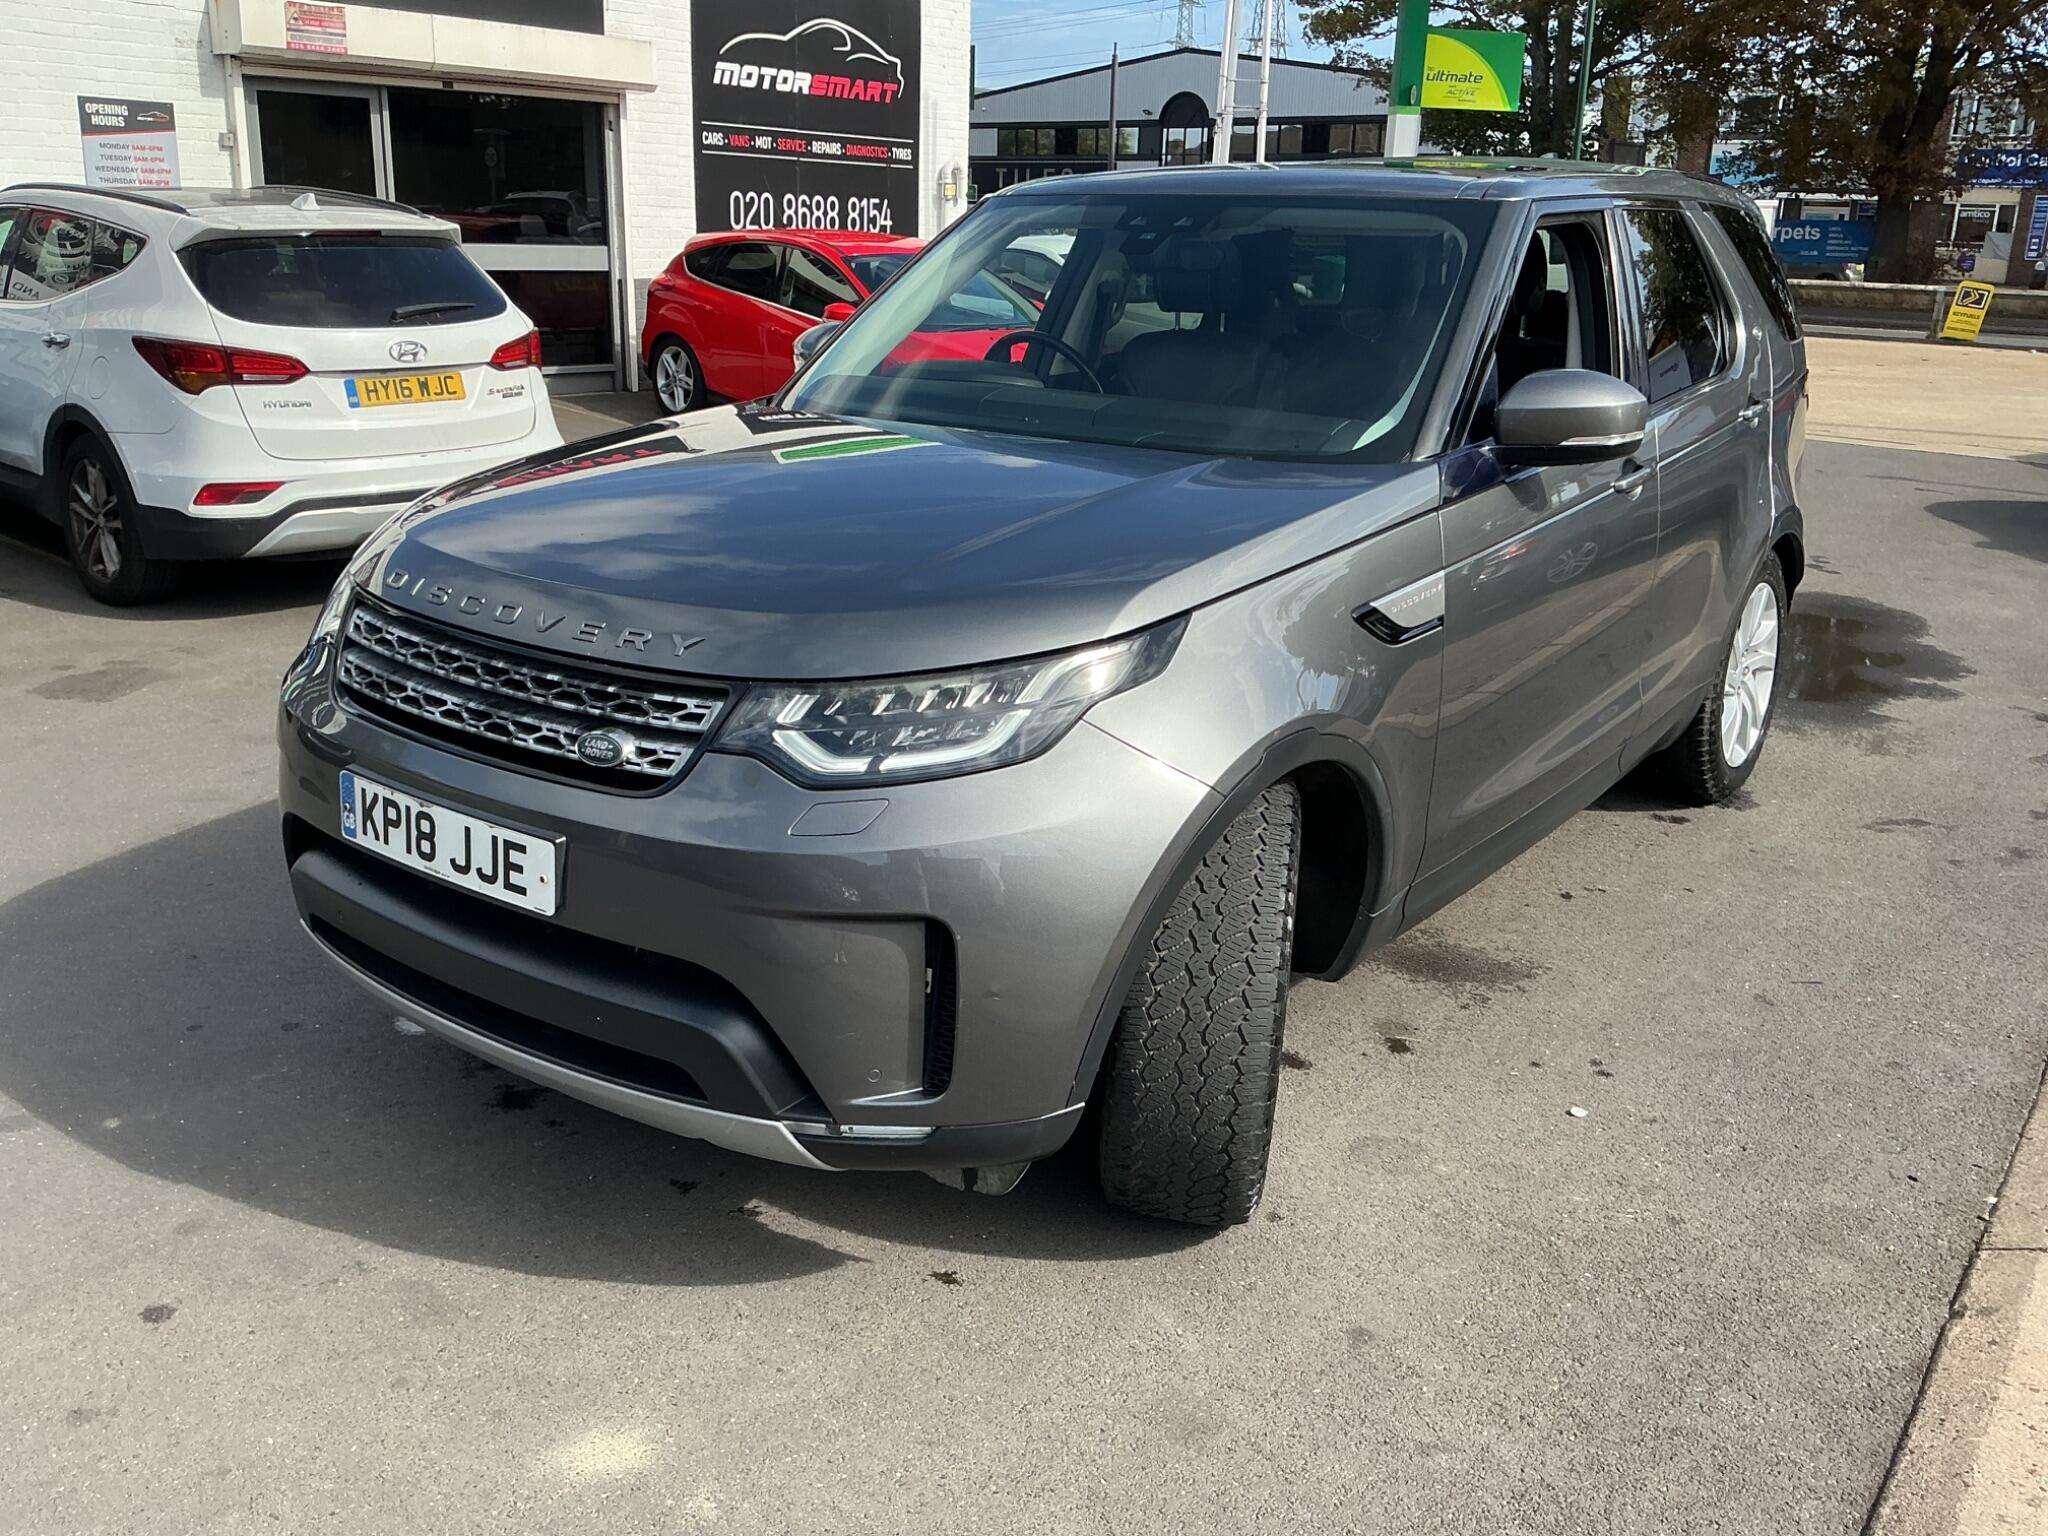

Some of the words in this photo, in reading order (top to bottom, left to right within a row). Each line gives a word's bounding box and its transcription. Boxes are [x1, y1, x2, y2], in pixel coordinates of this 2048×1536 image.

[713, 61, 898, 103] MOTORSMART
[1426, 70, 1483, 84] ultimate
[84, 102, 129, 116] OPENING
[91, 114, 126, 127] HOURS
[100, 142, 130, 151] MONDAY
[702, 131, 725, 146] CARS
[728, 134, 751, 148] VANS
[755, 137, 773, 150] MOT
[777, 138, 808, 152] SERVICE
[811, 140, 842, 156] REPAIRS
[846, 143, 888, 159] DIAGNOSTICS
[892, 147, 913, 161] TYRES
[100, 154, 132, 162] TUESDAY
[95, 165, 138, 174] WEDNESDAY
[99, 177, 136, 185] THURSDAY
[730, 191, 774, 230] 020
[783, 193, 839, 233] 8688
[847, 196, 893, 234] 8154
[364, 379, 413, 402] HY16
[418, 375, 457, 397] WJC
[386, 568, 706, 657] DISCOVERY
[361, 787, 437, 862] KP18
[449, 825, 527, 897] JJE
